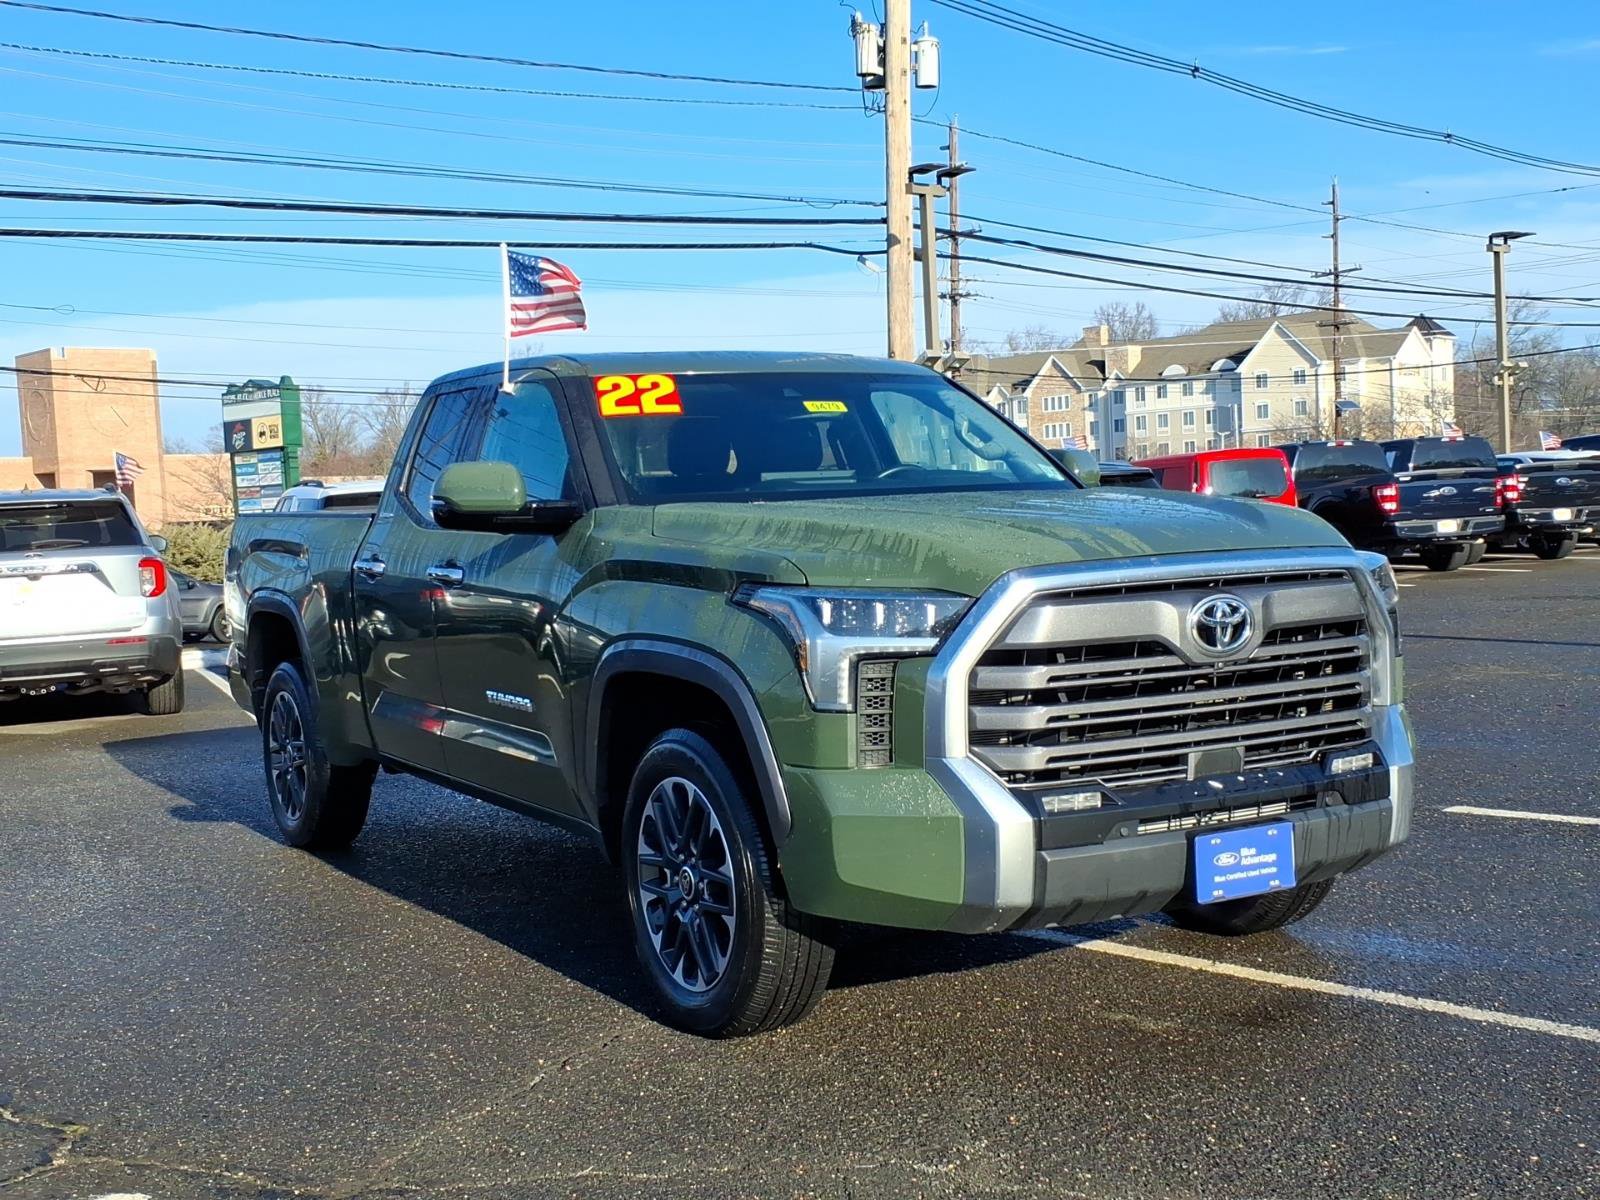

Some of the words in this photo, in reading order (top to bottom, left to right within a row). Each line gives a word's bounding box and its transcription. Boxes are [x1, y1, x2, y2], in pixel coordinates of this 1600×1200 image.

[597, 374, 682, 416] 22
[810, 402, 841, 411] 9479
[1240, 847, 1256, 857] Blue
[1241, 853, 1277, 865] Advantage
[1214, 875, 1226, 883] Blue
